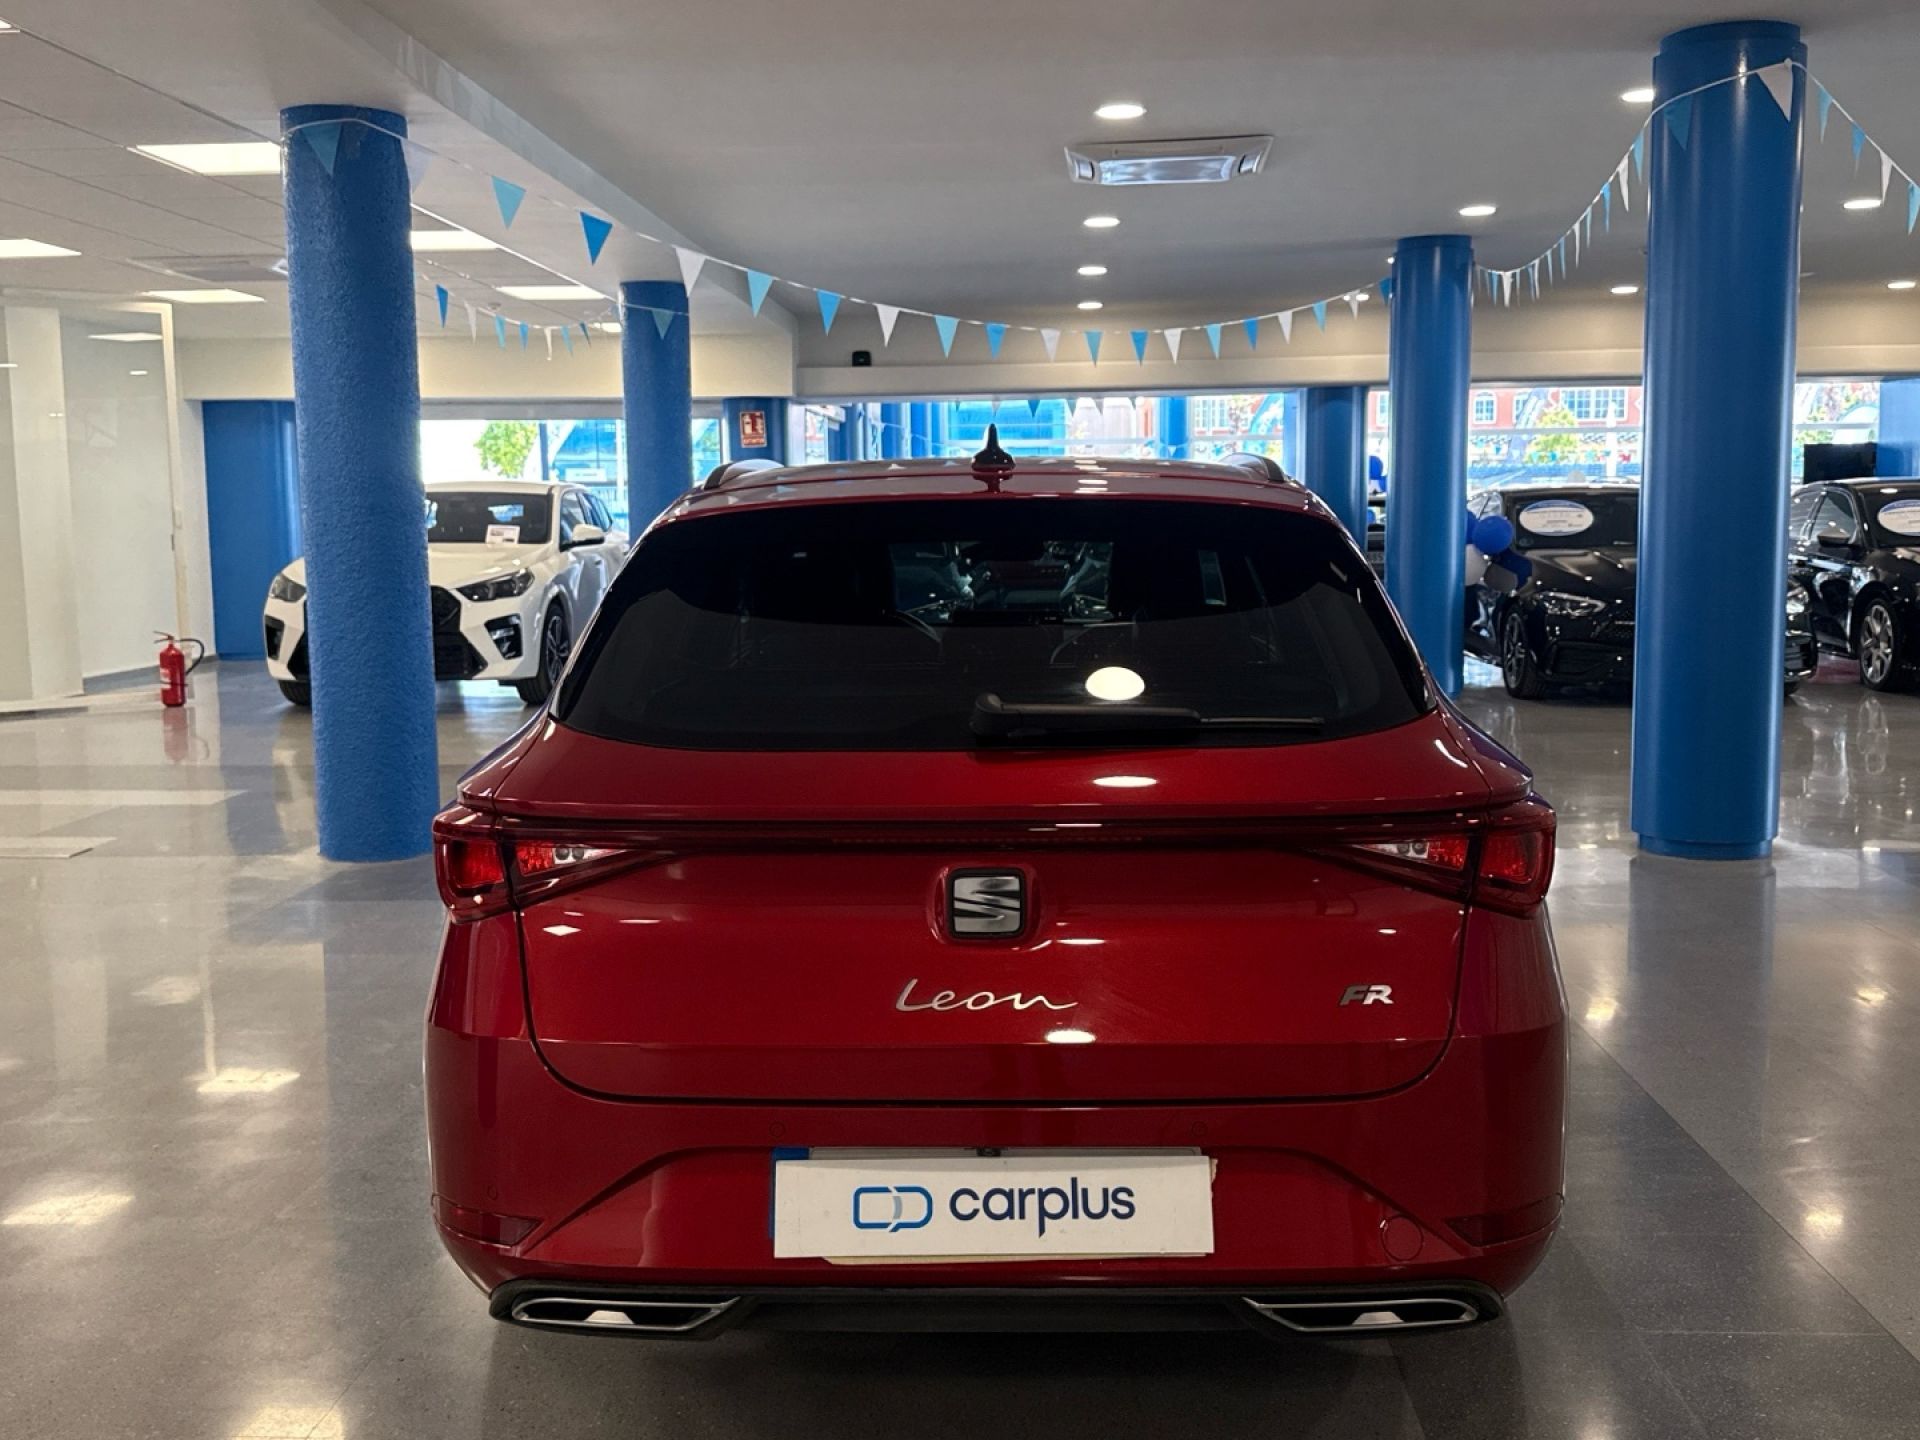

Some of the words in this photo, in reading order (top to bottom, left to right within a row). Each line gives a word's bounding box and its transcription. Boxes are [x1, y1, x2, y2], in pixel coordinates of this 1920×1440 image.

[896, 978, 1079, 1011] Leon
[1340, 984, 1394, 1005] FR
[949, 1177, 1136, 1239] carplus
